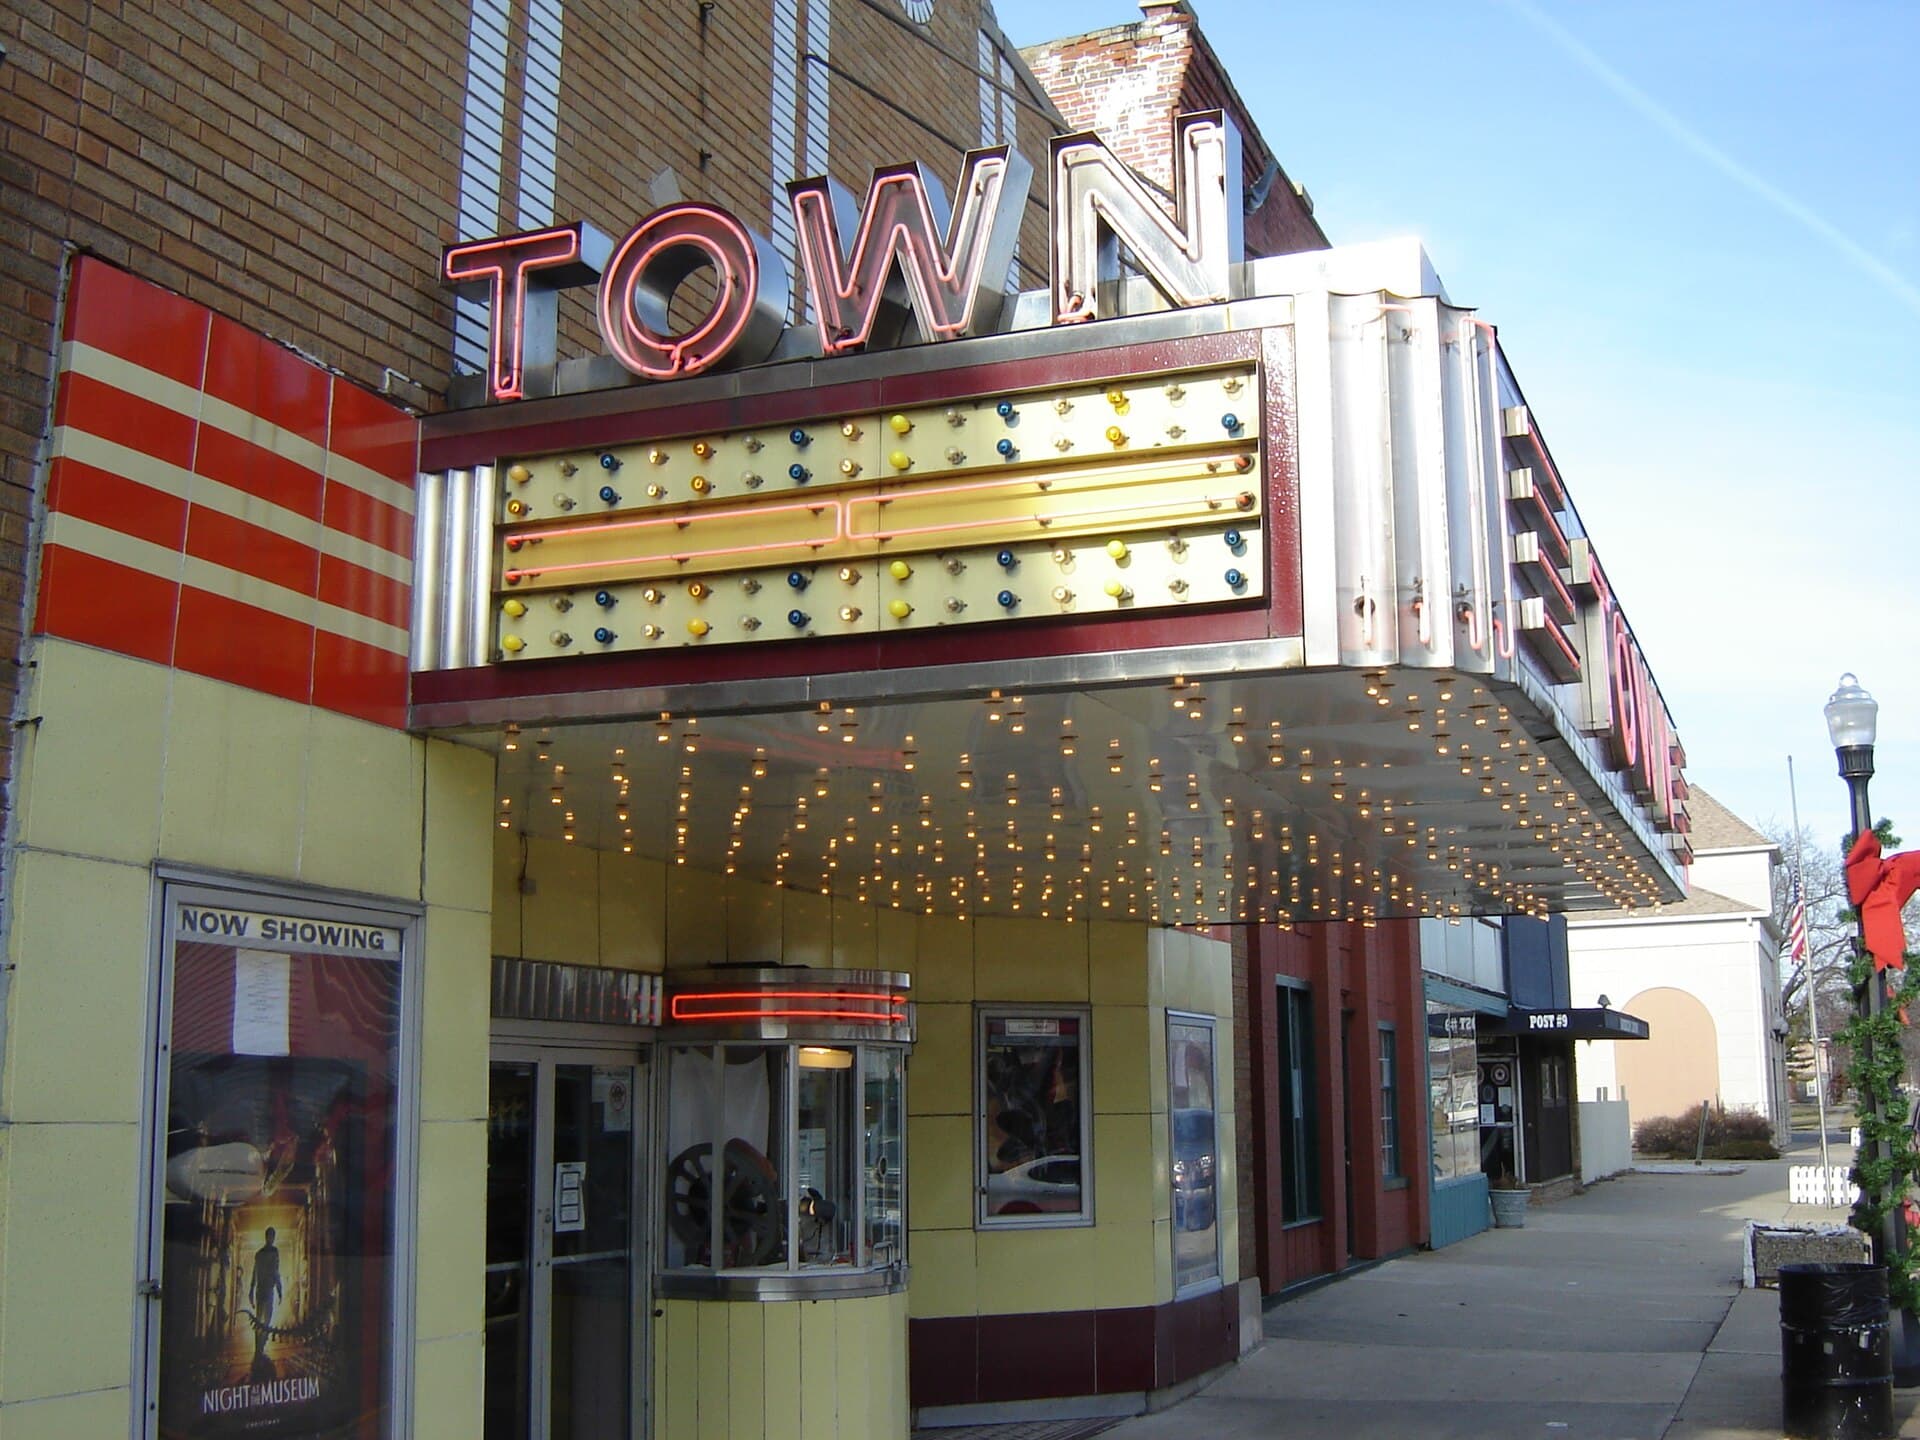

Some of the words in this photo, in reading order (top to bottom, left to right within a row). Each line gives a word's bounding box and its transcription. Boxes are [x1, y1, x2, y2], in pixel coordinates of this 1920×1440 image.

[442, 109, 1244, 403] TOWN
[181, 909, 249, 937] NOW
[260, 918, 385, 950] SHOWING
[1529, 1014, 1555, 1029] POST
[1556, 1013, 1568, 1028] #9
[203, 1384, 250, 1414] NIGHT
[261, 1376, 320, 1405] MUSEUM
